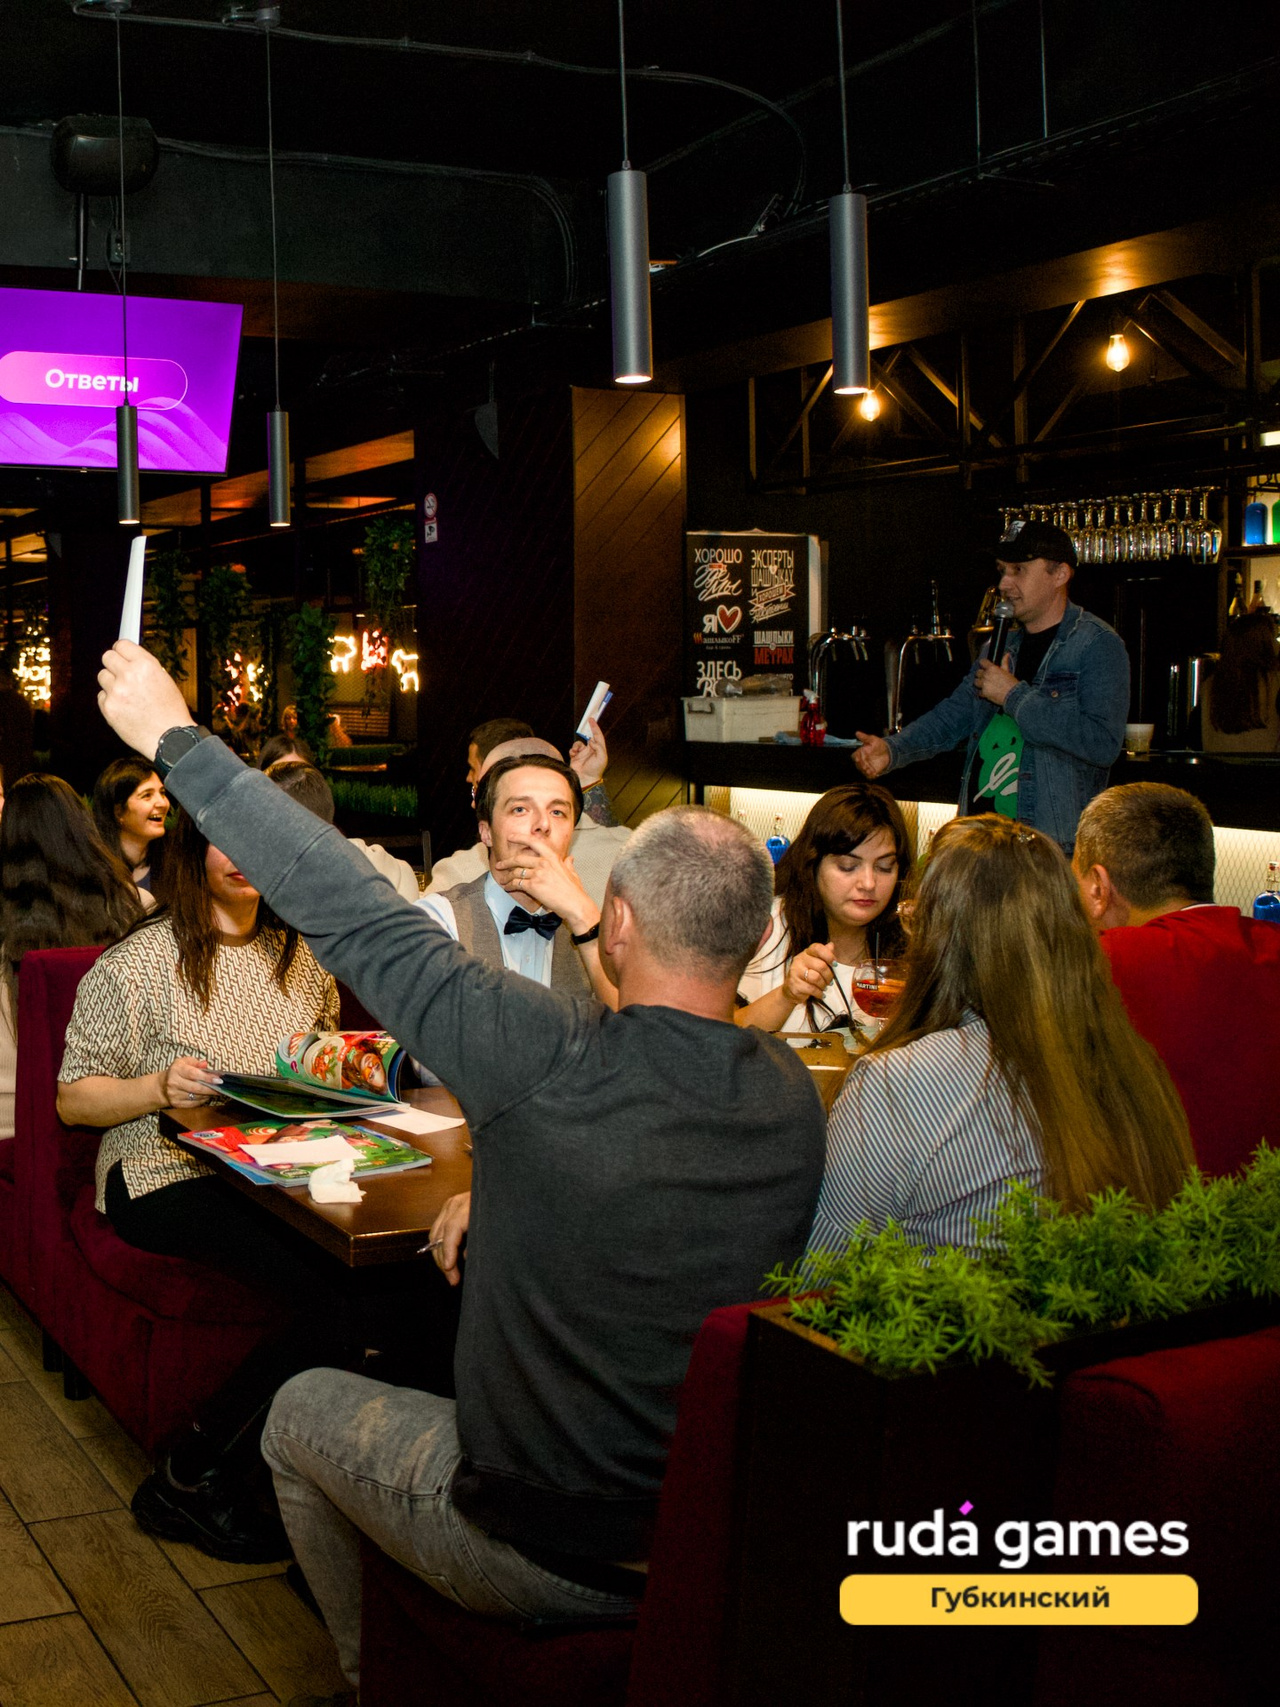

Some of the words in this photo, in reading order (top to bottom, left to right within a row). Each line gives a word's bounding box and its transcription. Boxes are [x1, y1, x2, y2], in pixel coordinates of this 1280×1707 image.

[45, 368, 139, 392] Ответы
[695, 548, 743, 563] ХОРОШО
[751, 549, 794, 568] ЭКСПЕРТЫ
[703, 614, 718, 633] Я
[754, 630, 794, 644] ШАШЛЫКИ
[754, 647, 794, 664] МЕТРАХ
[697, 660, 742, 680] ЗДЕСЬ
[856, 982, 878, 990] MARTINI
